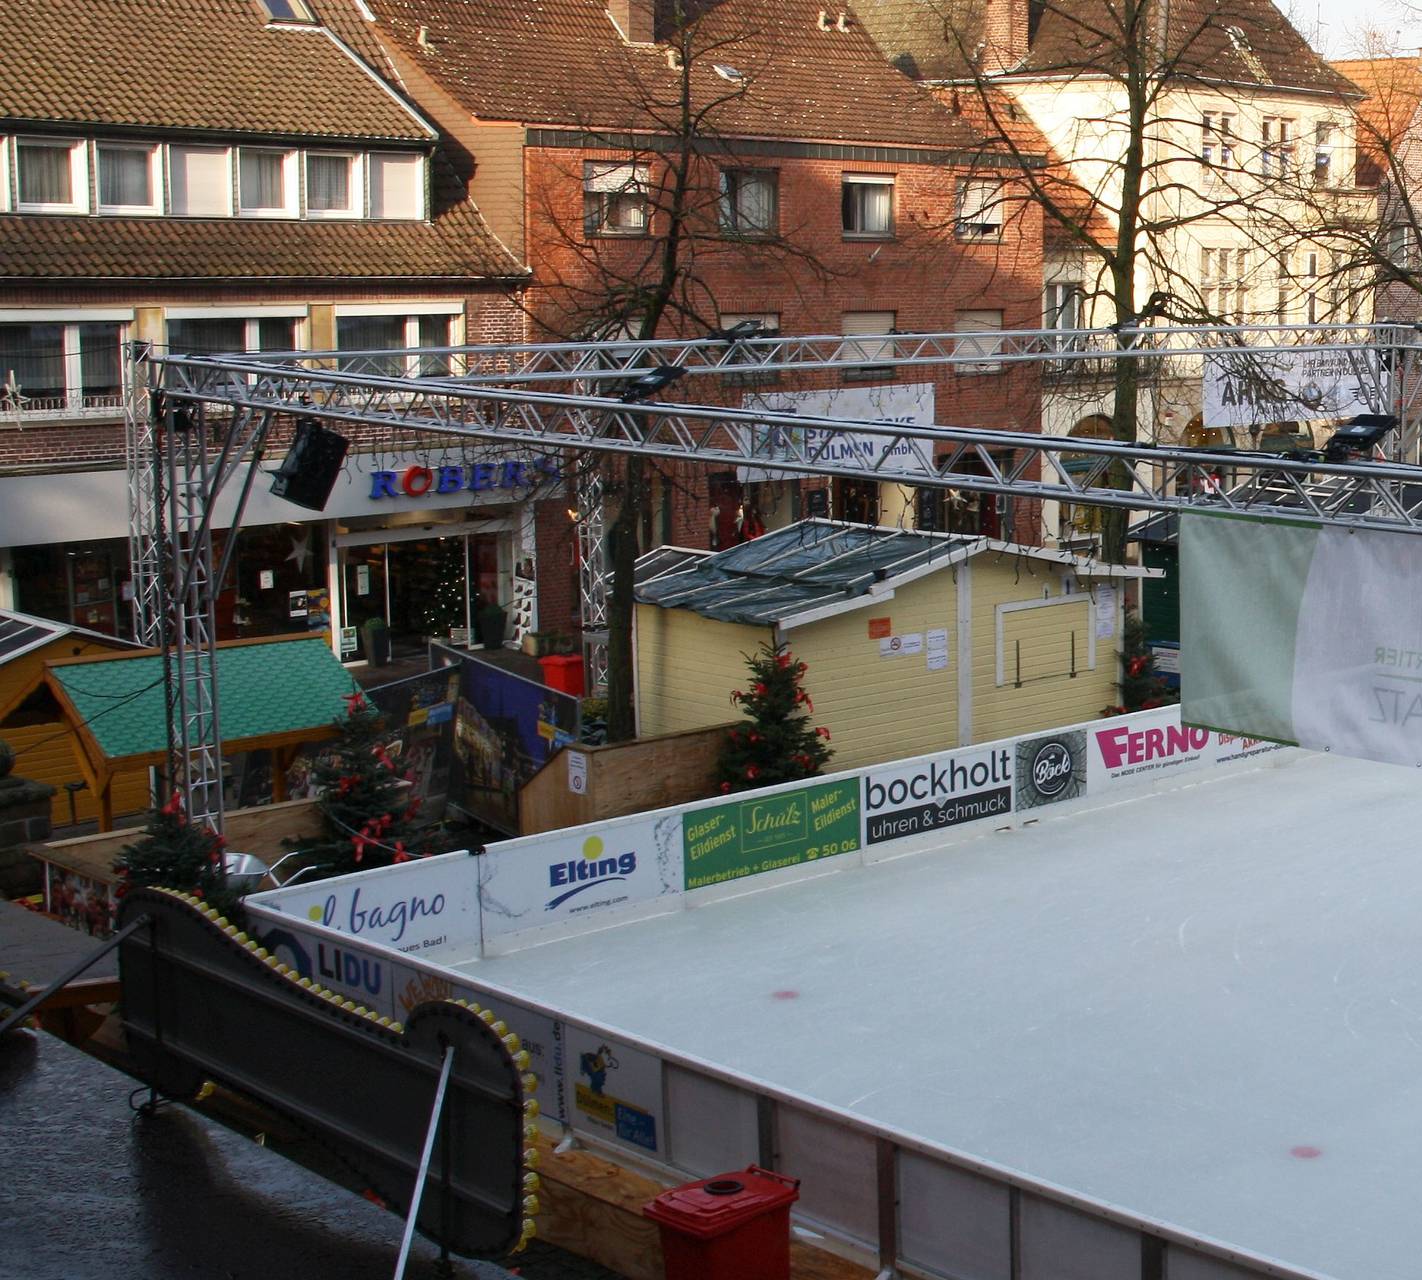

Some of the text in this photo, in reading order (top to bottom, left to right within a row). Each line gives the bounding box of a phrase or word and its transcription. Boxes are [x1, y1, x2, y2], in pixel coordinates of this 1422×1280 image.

[1095, 725, 1210, 769] FERNO
[865, 749, 1011, 811] bockholt
[1135, 764, 1154, 774] CENTER
[811, 790, 843, 814] Maler-
[814, 798, 857, 831] Eildienst
[872, 795, 1007, 839] uhren & schmuck
[687, 814, 726, 842] Glaser-
[690, 824, 737, 861] Eildienst
[549, 849, 637, 888] Elting
[688, 865, 750, 888] Malerbetrieb
[761, 854, 800, 871] Glaserei
[822, 843, 838, 857] 50
[351, 887, 446, 942] bagno
[569, 895, 629, 914] www.elting.com
[318, 943, 382, 996] LIDU
